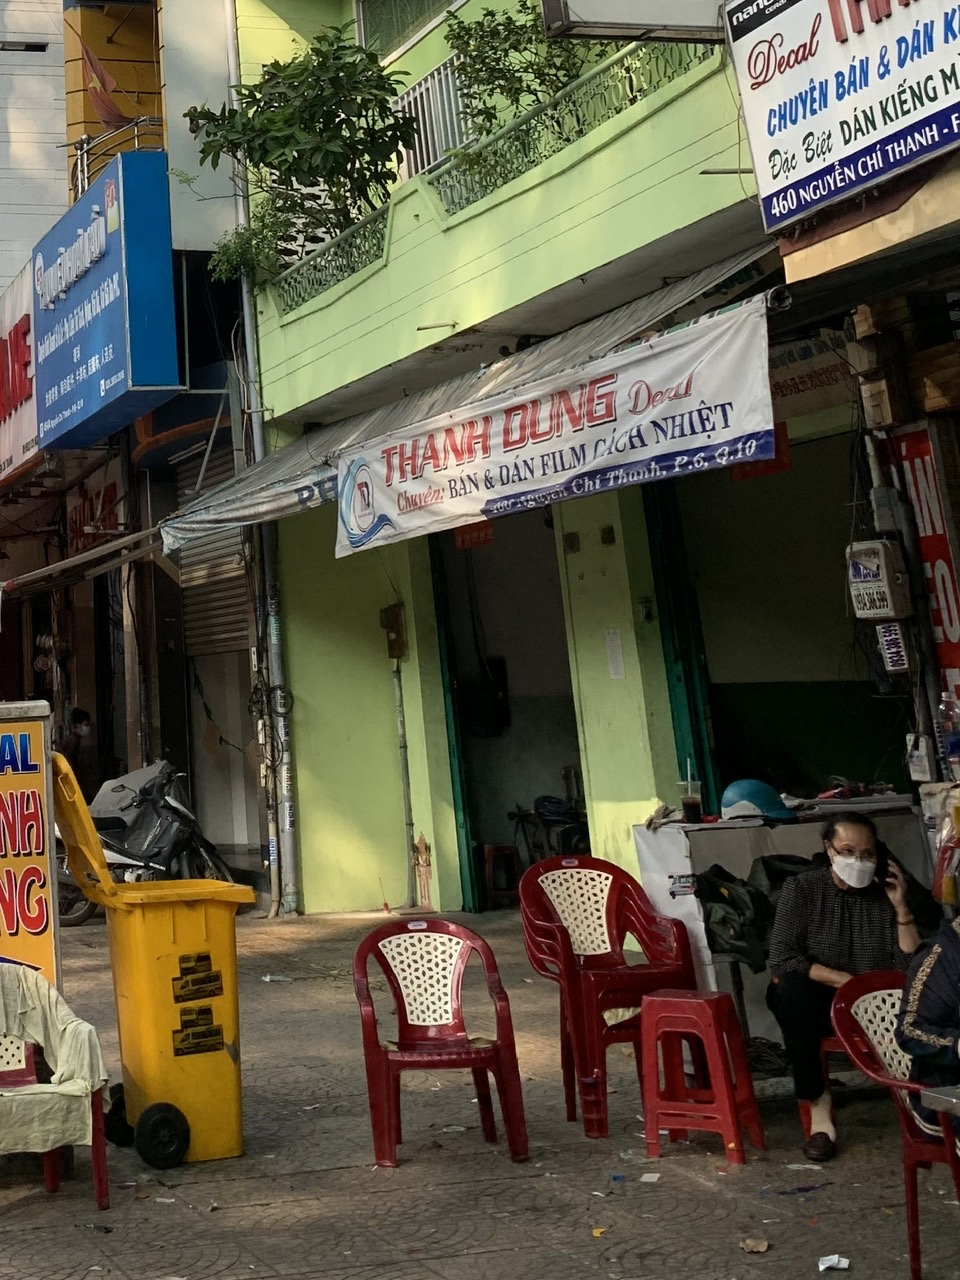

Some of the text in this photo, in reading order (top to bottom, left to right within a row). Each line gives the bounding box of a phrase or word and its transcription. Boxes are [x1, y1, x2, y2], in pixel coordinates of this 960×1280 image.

[747, 12, 822, 91] Decal
[767, 78, 829, 138] CHUYÊN
[834, 55, 870, 103] BÁN
[877, 44, 891, 81] &
[895, 19, 935, 70] DÁN
[768, 147, 798, 182] Đặc
[802, 130, 834, 167] Biệt
[839, 105, 878, 147] DÁN
[878, 75, 939, 132] KIẾNG
[770, 189, 798, 218] 460
[799, 160, 856, 210] NGUYỄN
[857, 145, 885, 180] CHÍ
[885, 123, 939, 168] THANH
[380, 415, 493, 488] THANH
[502, 373, 618, 453] DUNG
[448, 471, 481, 501] BÁN
[484, 468, 497, 491] &
[499, 454, 536, 487] DÁN
[540, 443, 587, 477] FILM
[592, 424, 648, 461] CÁCH
[650, 399, 734, 445] NHIỆT
[571, 475, 602, 495] Chí
